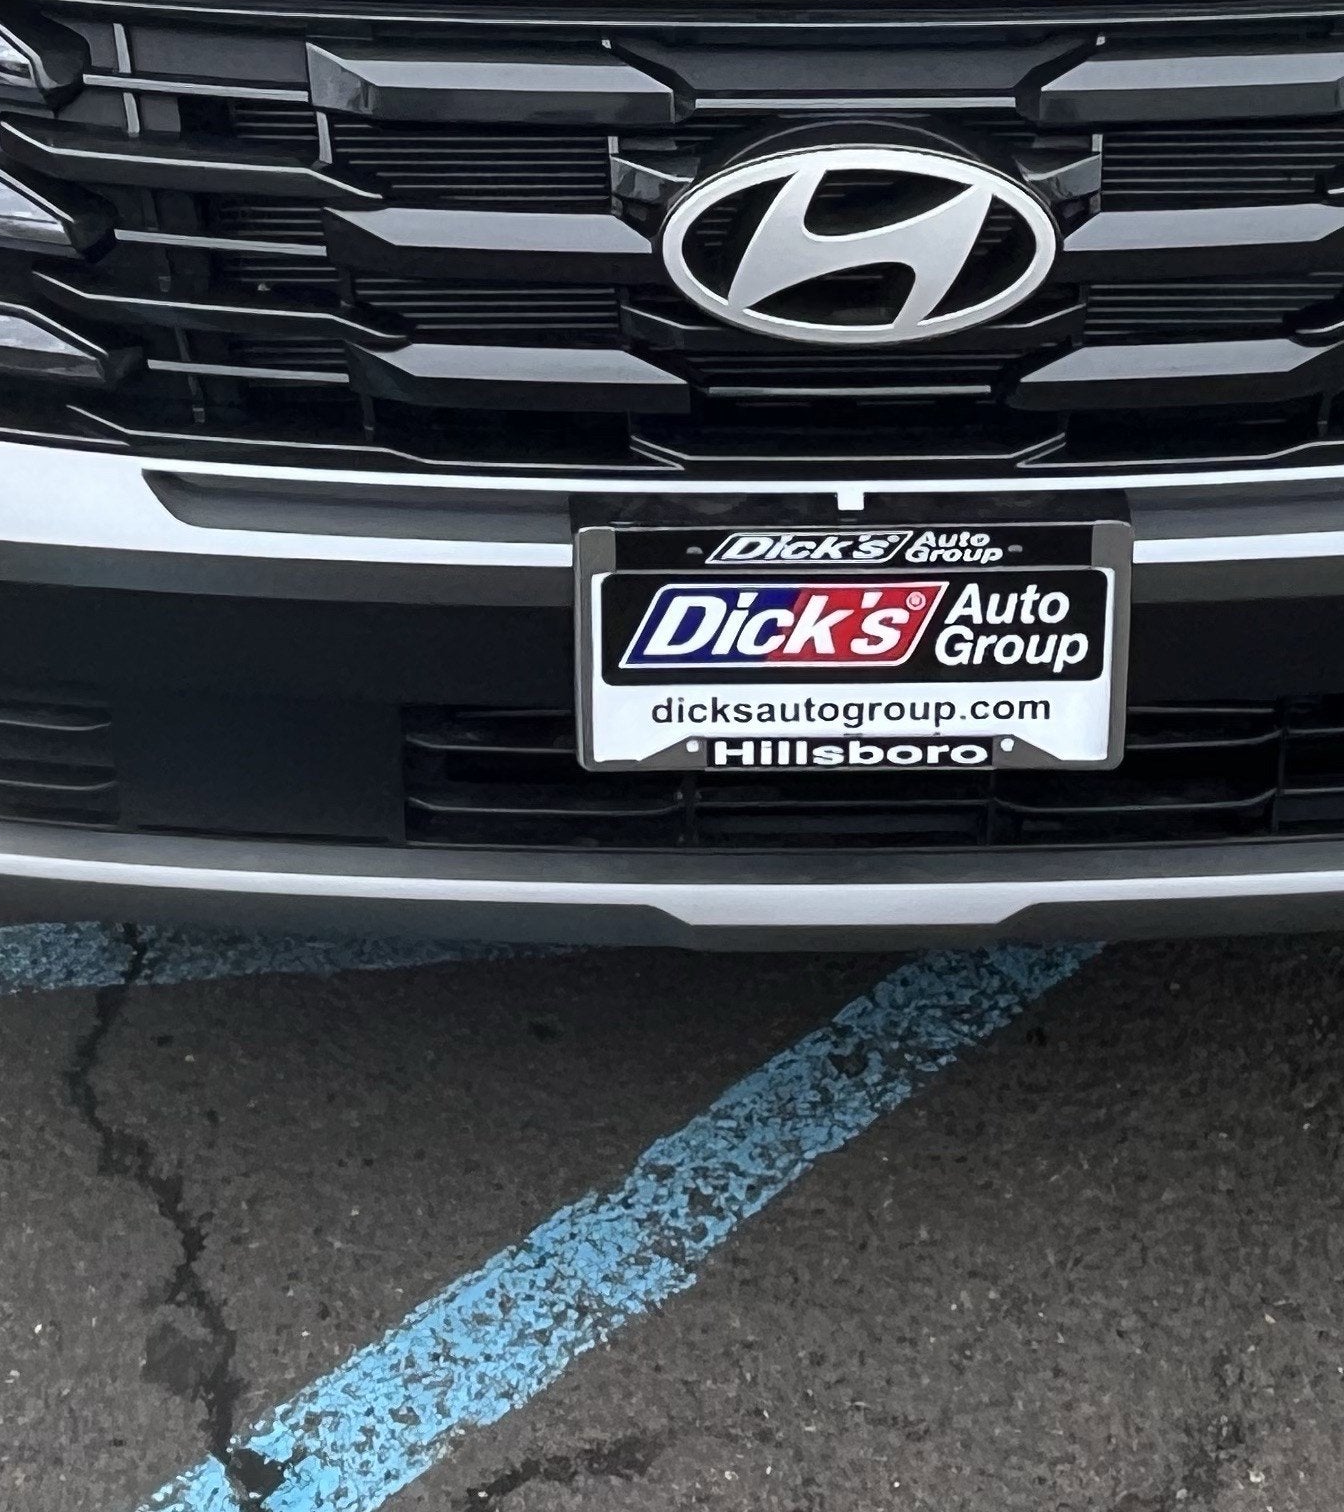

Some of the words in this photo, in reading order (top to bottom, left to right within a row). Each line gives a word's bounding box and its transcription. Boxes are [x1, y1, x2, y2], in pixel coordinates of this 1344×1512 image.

[722, 534, 888, 561] Dick's
[915, 531, 990, 548] Auto
[904, 545, 1004, 564] Group
[643, 590, 911, 657] Dick's
[944, 583, 1070, 625] Auto
[934, 624, 1089, 673] Group
[651, 696, 1051, 728] dicksautogroup.com
[713, 739, 989, 767] Hillsboro
